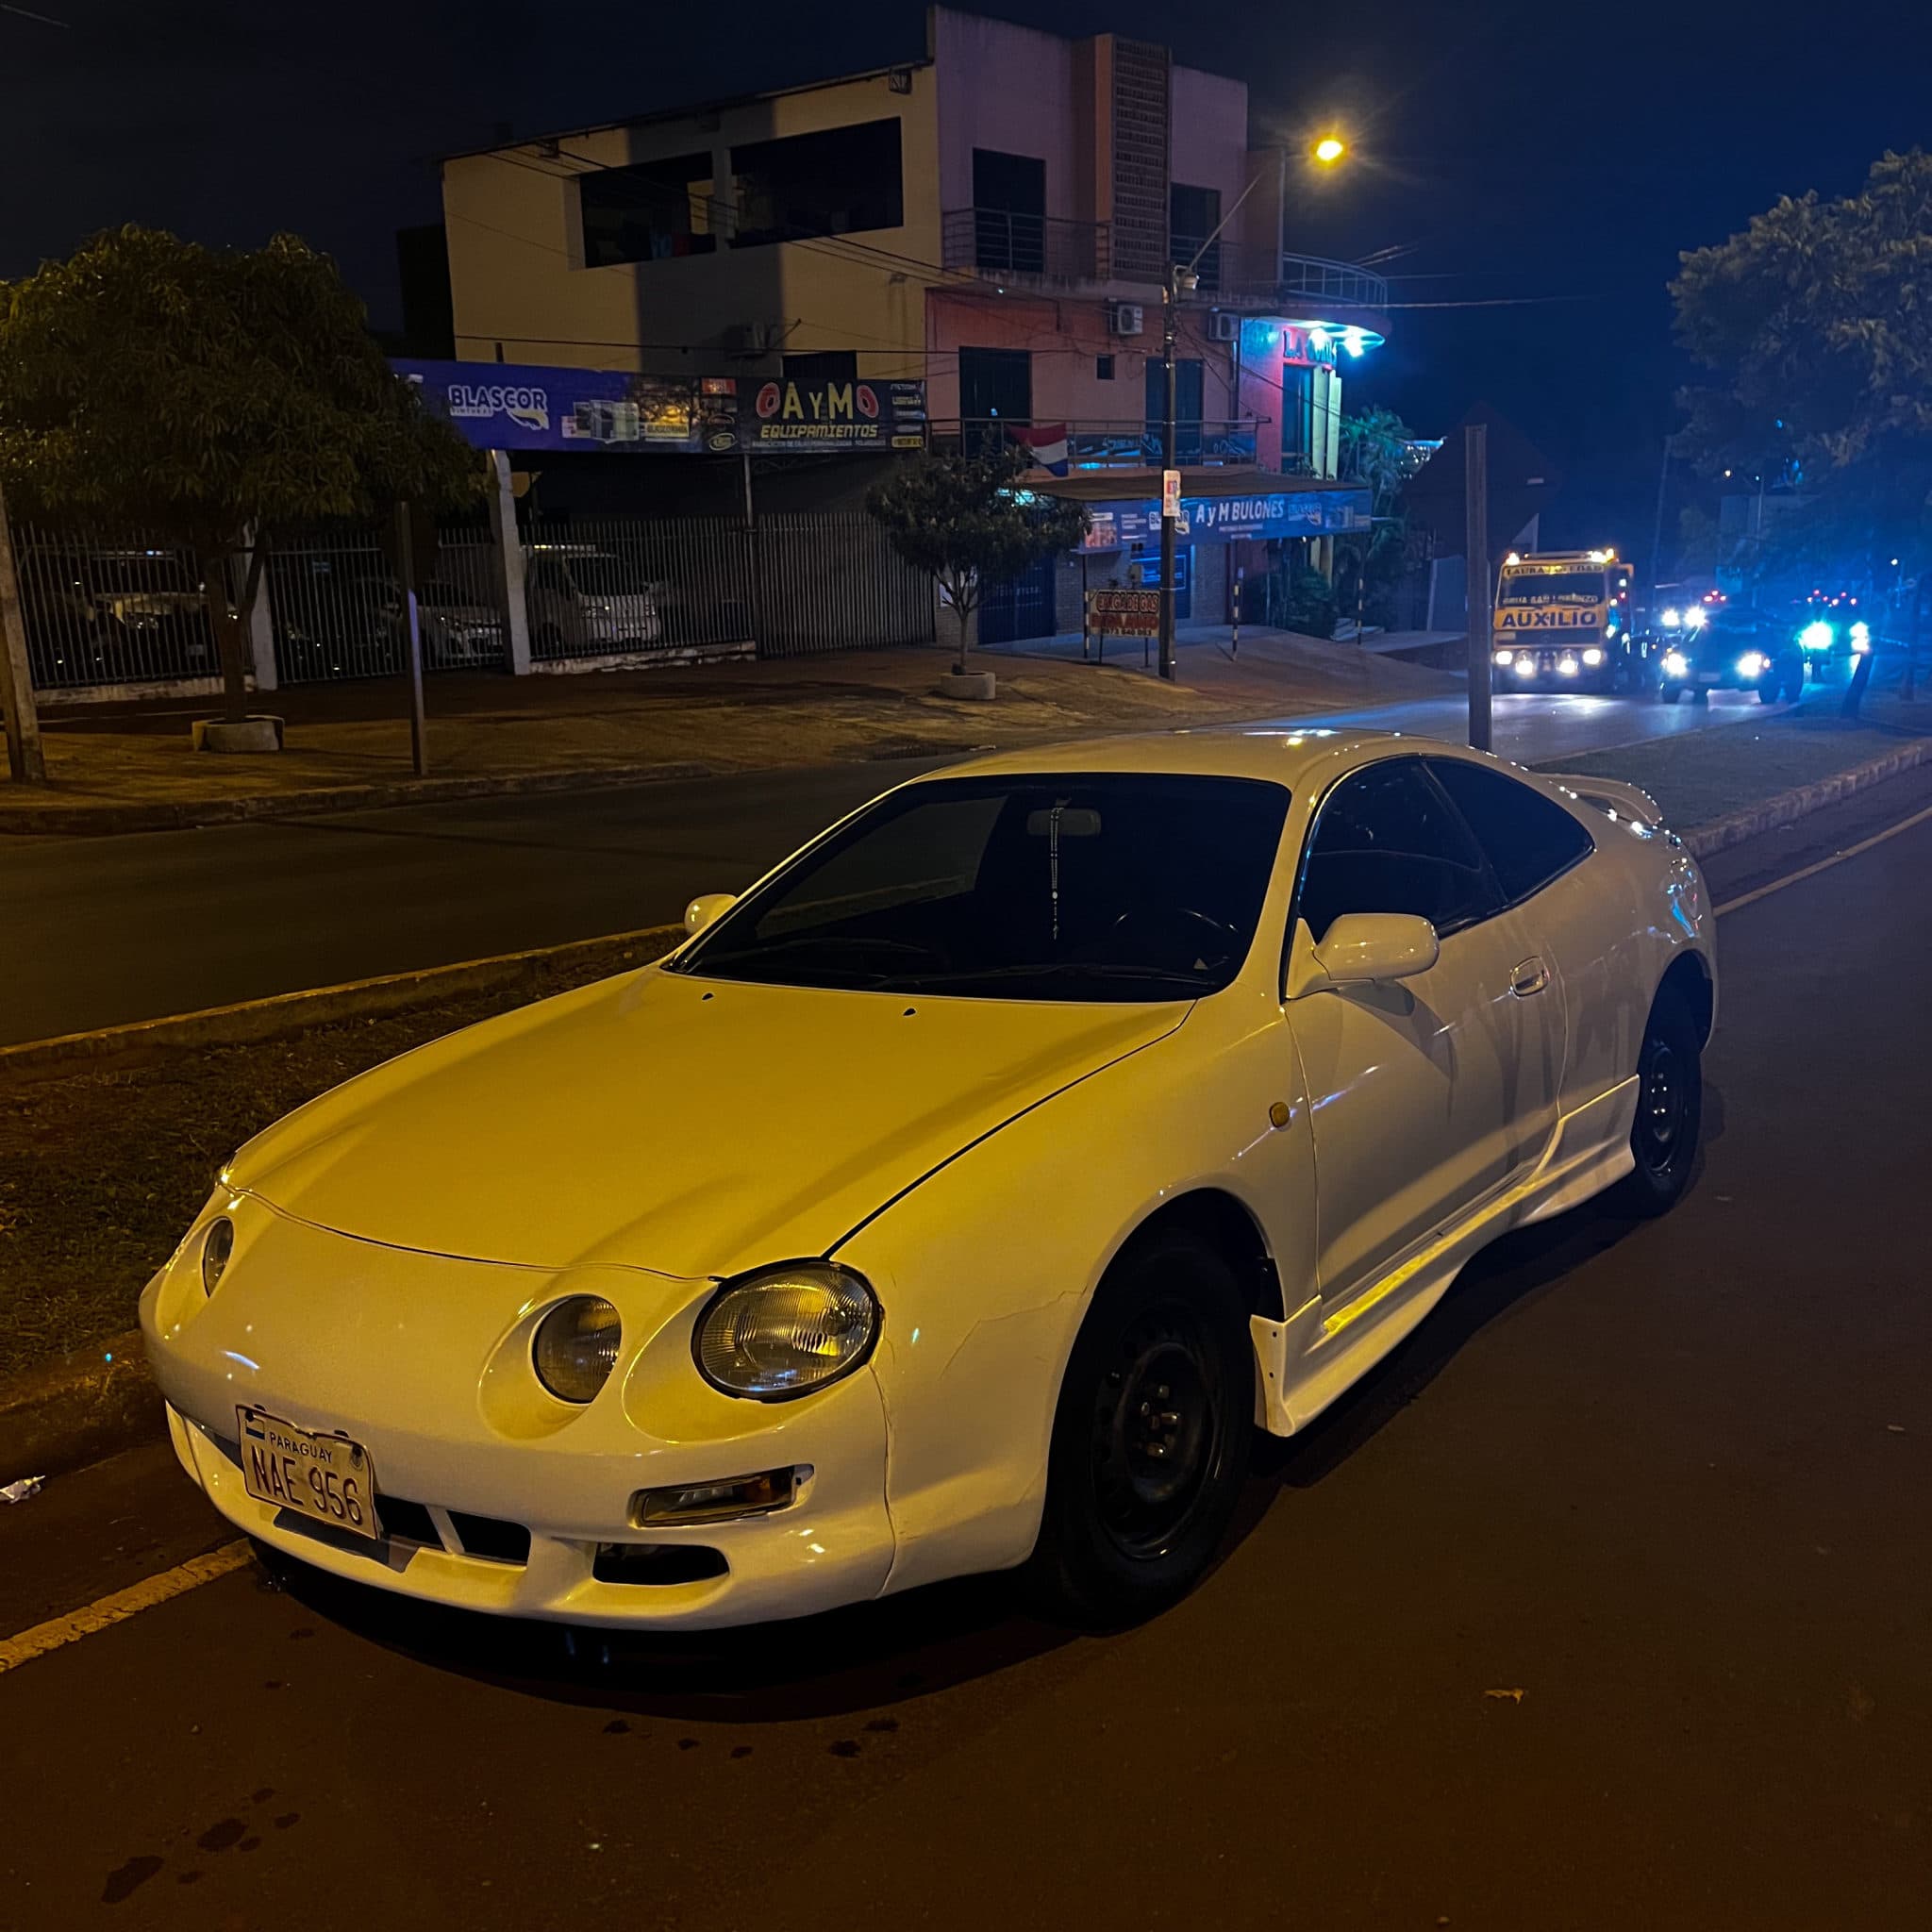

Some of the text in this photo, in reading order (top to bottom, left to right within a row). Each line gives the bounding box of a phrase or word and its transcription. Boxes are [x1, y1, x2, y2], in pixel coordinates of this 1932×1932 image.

[450, 386, 547, 410] BLASCOR
[782, 381, 804, 419] A
[827, 382, 854, 419] M
[760, 425, 879, 438] EQUIPAMIENTOS
[1195, 498, 1285, 527] A y M BULONES
[1502, 610, 1597, 626] AUXILIO
[269, 1432, 332, 1463] PARAGUAY
[251, 1445, 363, 1526] NAE 956
